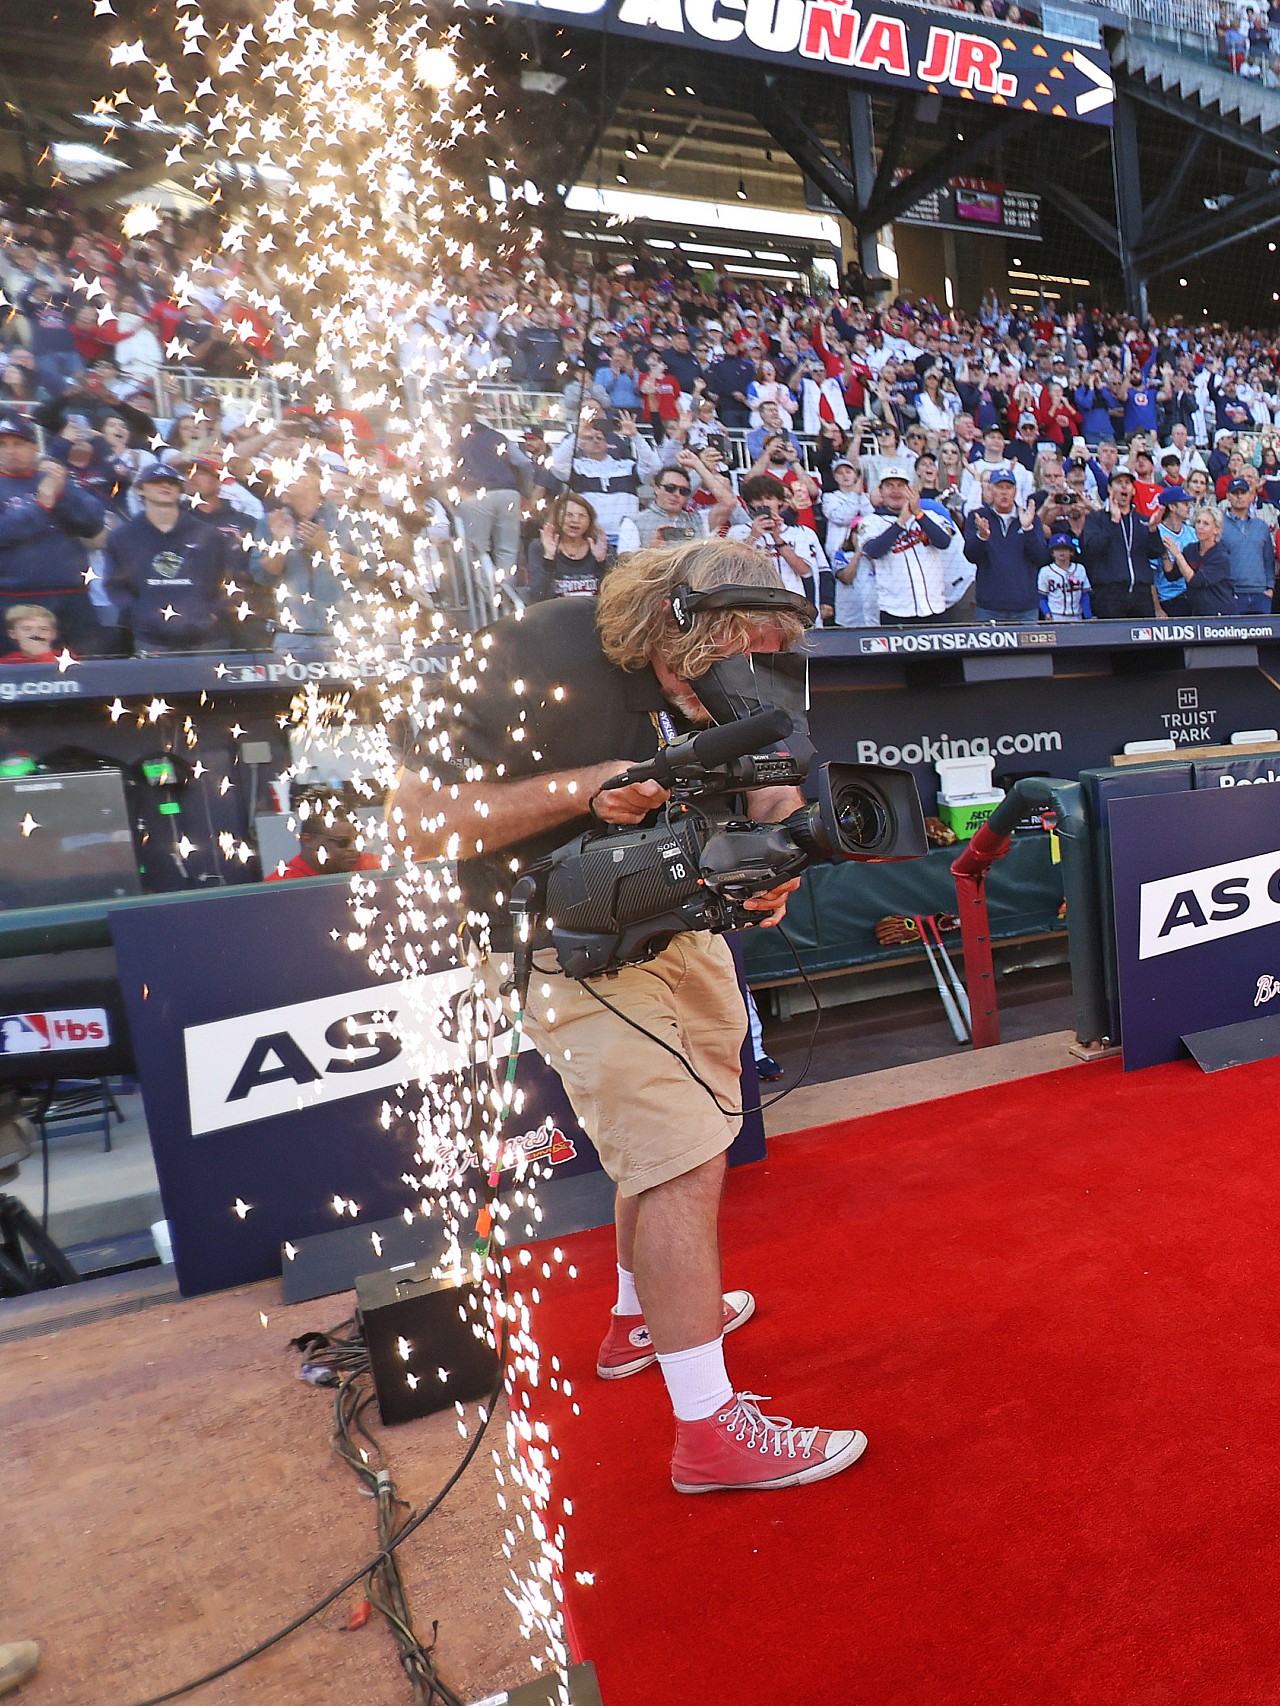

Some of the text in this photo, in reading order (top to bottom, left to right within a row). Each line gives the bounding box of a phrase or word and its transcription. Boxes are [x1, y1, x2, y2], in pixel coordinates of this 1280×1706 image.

[917, 27, 1017, 97] JR.
[889, 631, 1057, 652] POSTSEASON 2023
[1152, 625, 1273, 641] NLDS Booking.com
[1161, 710, 1217, 728] TRUIST
[1170, 727, 1211, 742] PARK
[857, 731, 1063, 766] Booking.com
[657, 839, 685, 852] SON
[669, 863, 686, 880] 18
[1157, 877, 1251, 938] AS
[54, 1019, 104, 1041] tbs
[224, 1009, 402, 1103] AS
